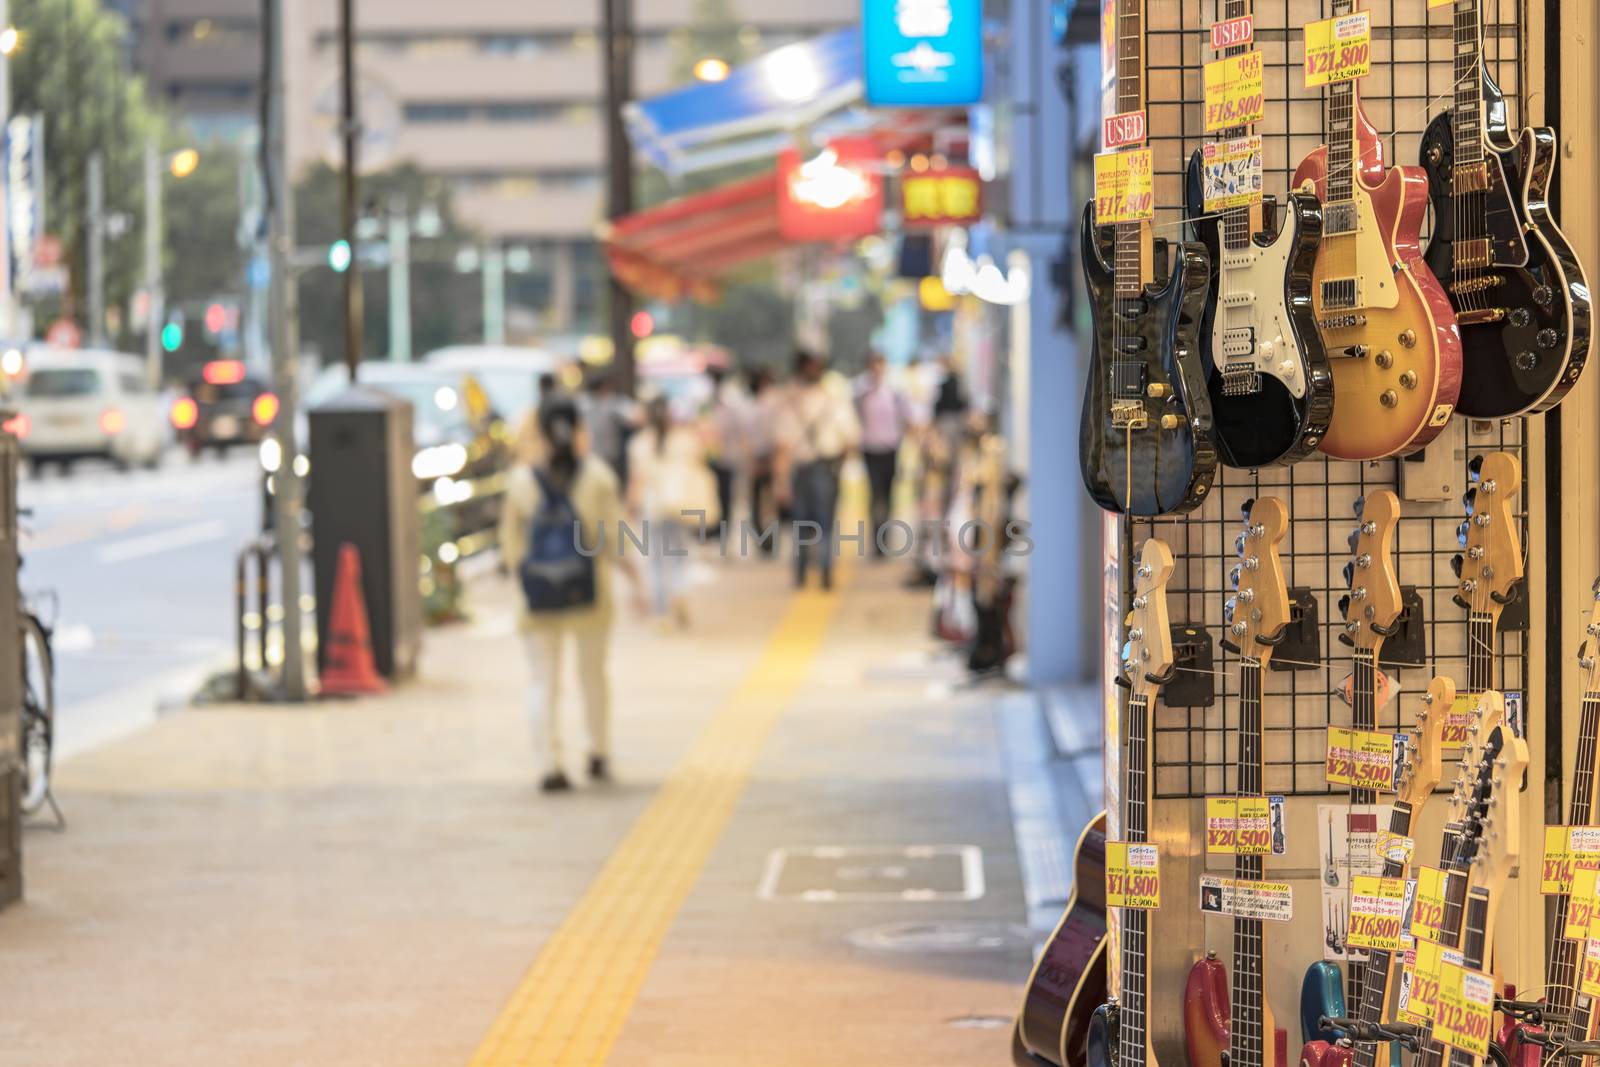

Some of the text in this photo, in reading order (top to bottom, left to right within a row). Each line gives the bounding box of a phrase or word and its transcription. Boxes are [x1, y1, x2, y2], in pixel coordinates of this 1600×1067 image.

[1213, 20, 1251, 46] USED
[1238, 54, 1259, 72] 中古
[1308, 43, 1368, 75] ¥21,800
[1208, 93, 1262, 123] ¥18,800
[1107, 115, 1145, 144] USED
[1328, 759, 1391, 782] ¥20,500
[1208, 830, 1269, 847] ¥20,500
[1108, 875, 1158, 897] ¥14,800
[1125, 898, 1153, 907] ¥15,900
[1350, 915, 1400, 939] ¥16,800
[1437, 1001, 1489, 1041] ¥12,800
